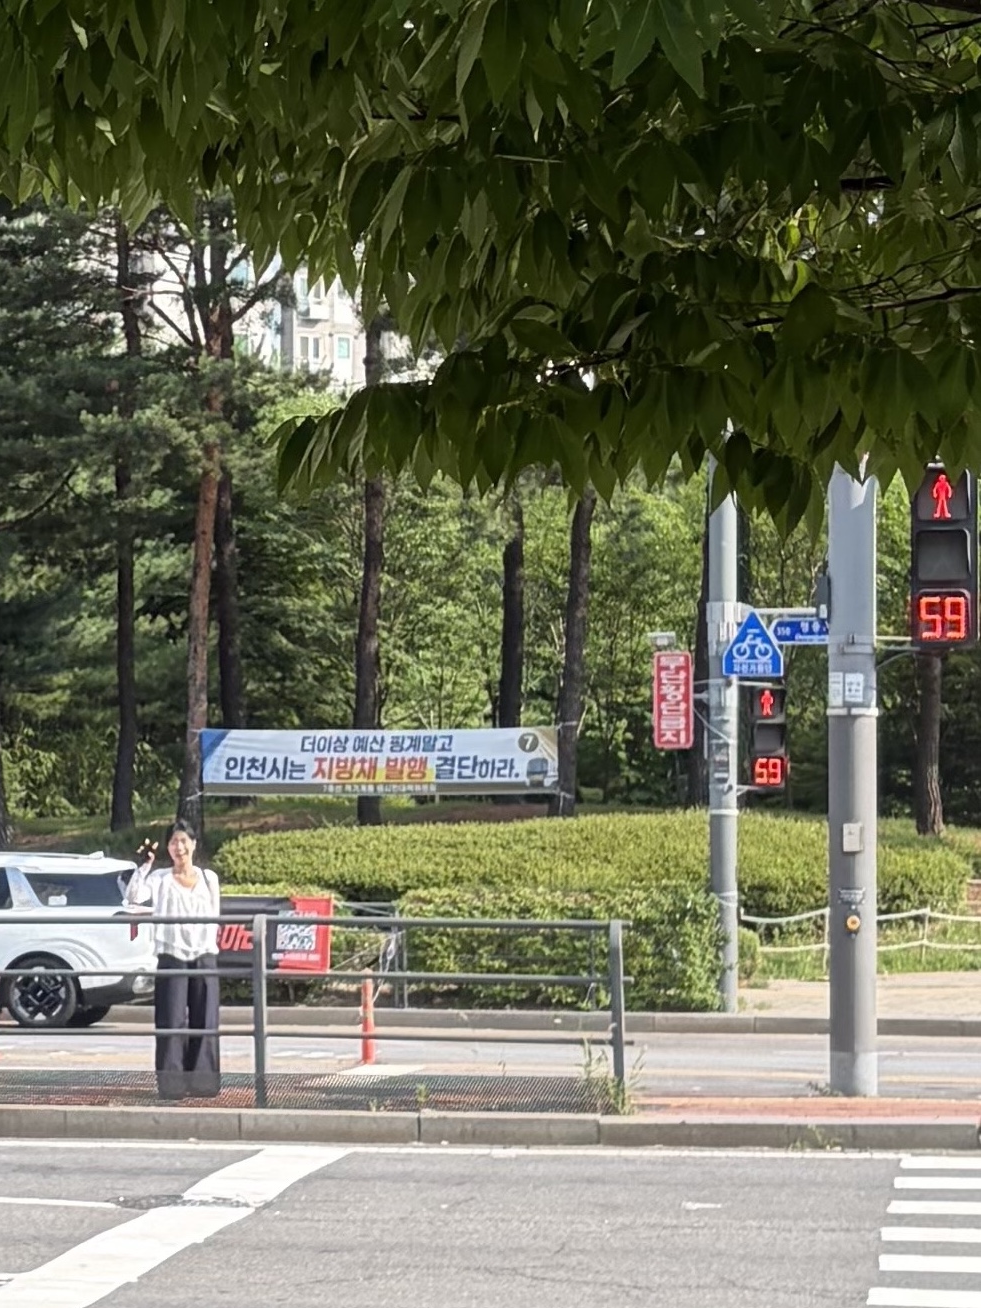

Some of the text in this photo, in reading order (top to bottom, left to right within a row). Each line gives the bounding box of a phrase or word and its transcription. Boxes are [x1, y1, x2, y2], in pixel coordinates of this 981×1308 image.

[920, 596, 966, 640] 59
[300, 734, 453, 753] 더이상 예산 핑계말고
[225, 755, 520, 780] 인천시는 지방채 발행 결단하라.
[754, 757, 781, 785] 59
